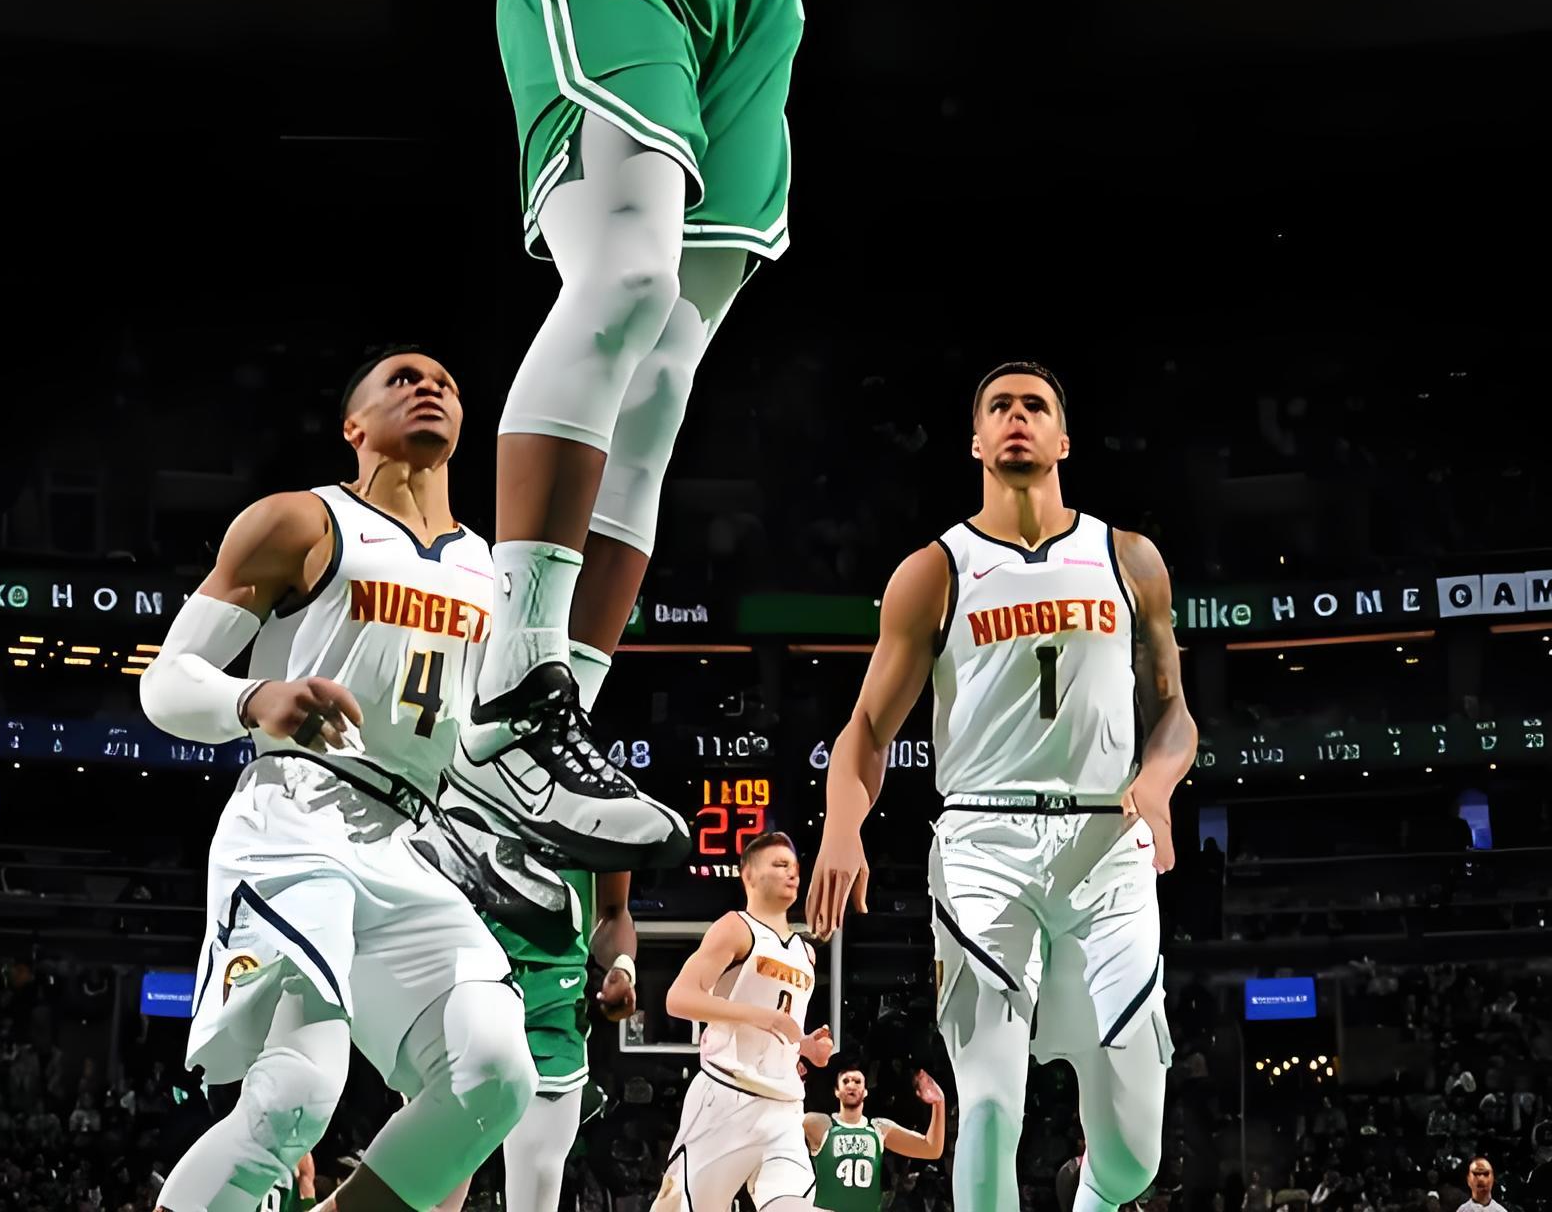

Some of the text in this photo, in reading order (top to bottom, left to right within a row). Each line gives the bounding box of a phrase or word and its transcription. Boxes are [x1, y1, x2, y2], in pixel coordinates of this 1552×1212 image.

[52, 583, 188, 615] HOM
[350, 579, 492, 644] NUGGET
[967, 599, 1117, 647] NUGGETS
[1187, 597, 1252, 628] like
[1271, 588, 1421, 621] HOME
[401, 650, 445, 739] 4
[1035, 645, 1061, 720] 1
[607, 740, 651, 769] 48
